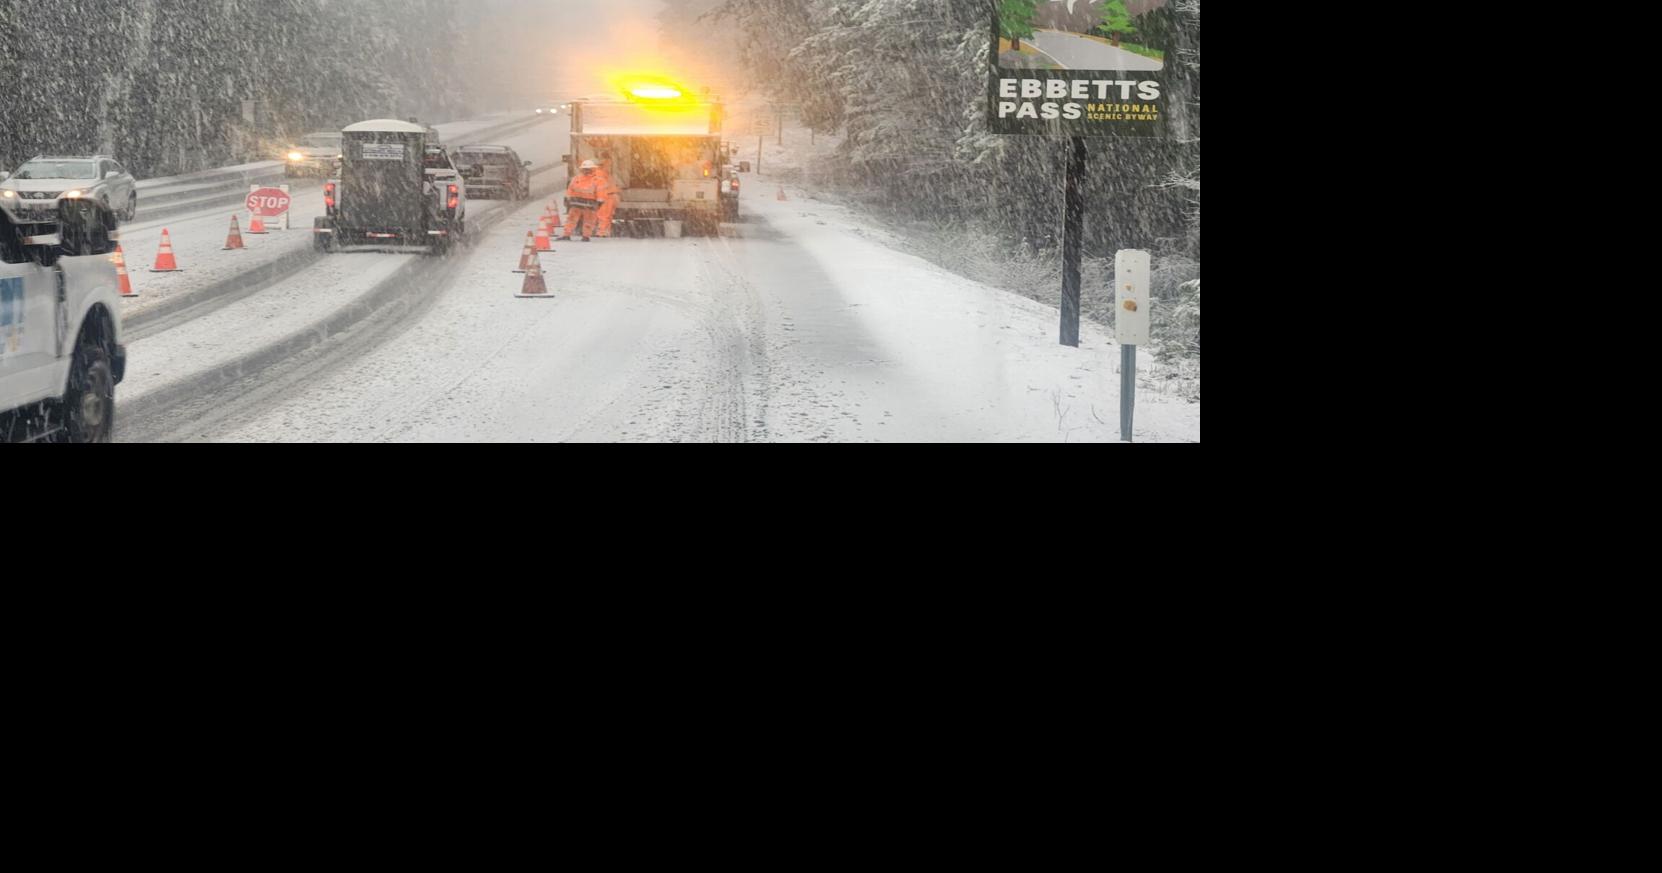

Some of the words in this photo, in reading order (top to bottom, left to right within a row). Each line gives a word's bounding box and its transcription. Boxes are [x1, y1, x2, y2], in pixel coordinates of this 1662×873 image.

[1000, 78, 1160, 100] EBBETTS
[999, 101, 1081, 120] PASS
[1087, 103, 1158, 113] NATIONAL
[248, 195, 289, 209] STOP
